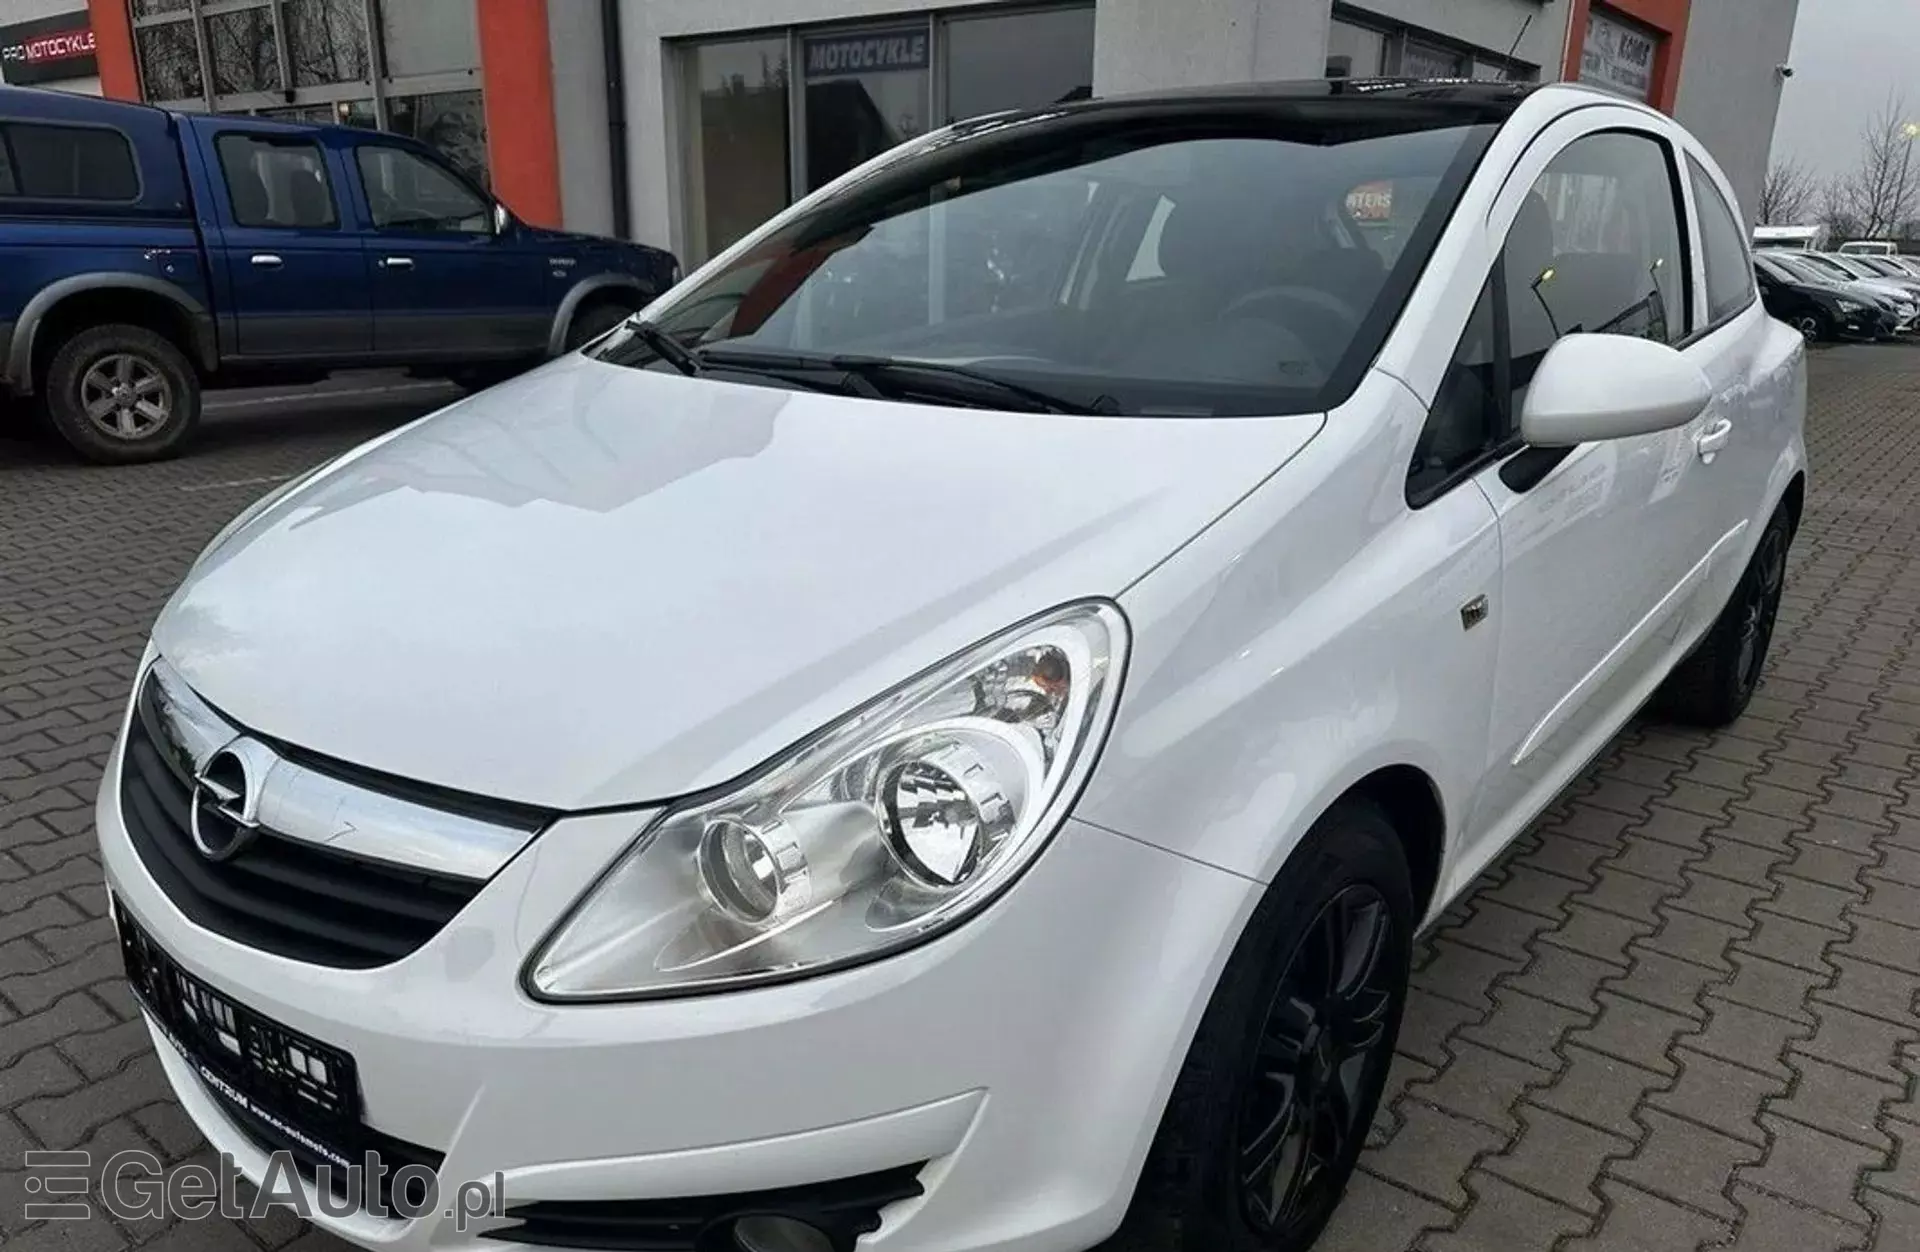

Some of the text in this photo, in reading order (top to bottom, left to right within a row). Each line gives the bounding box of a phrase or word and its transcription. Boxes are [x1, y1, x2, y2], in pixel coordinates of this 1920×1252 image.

[2, 32, 97, 60] PRO MOTOCYKLE
[808, 35, 925, 70] MOTOCYKLE
